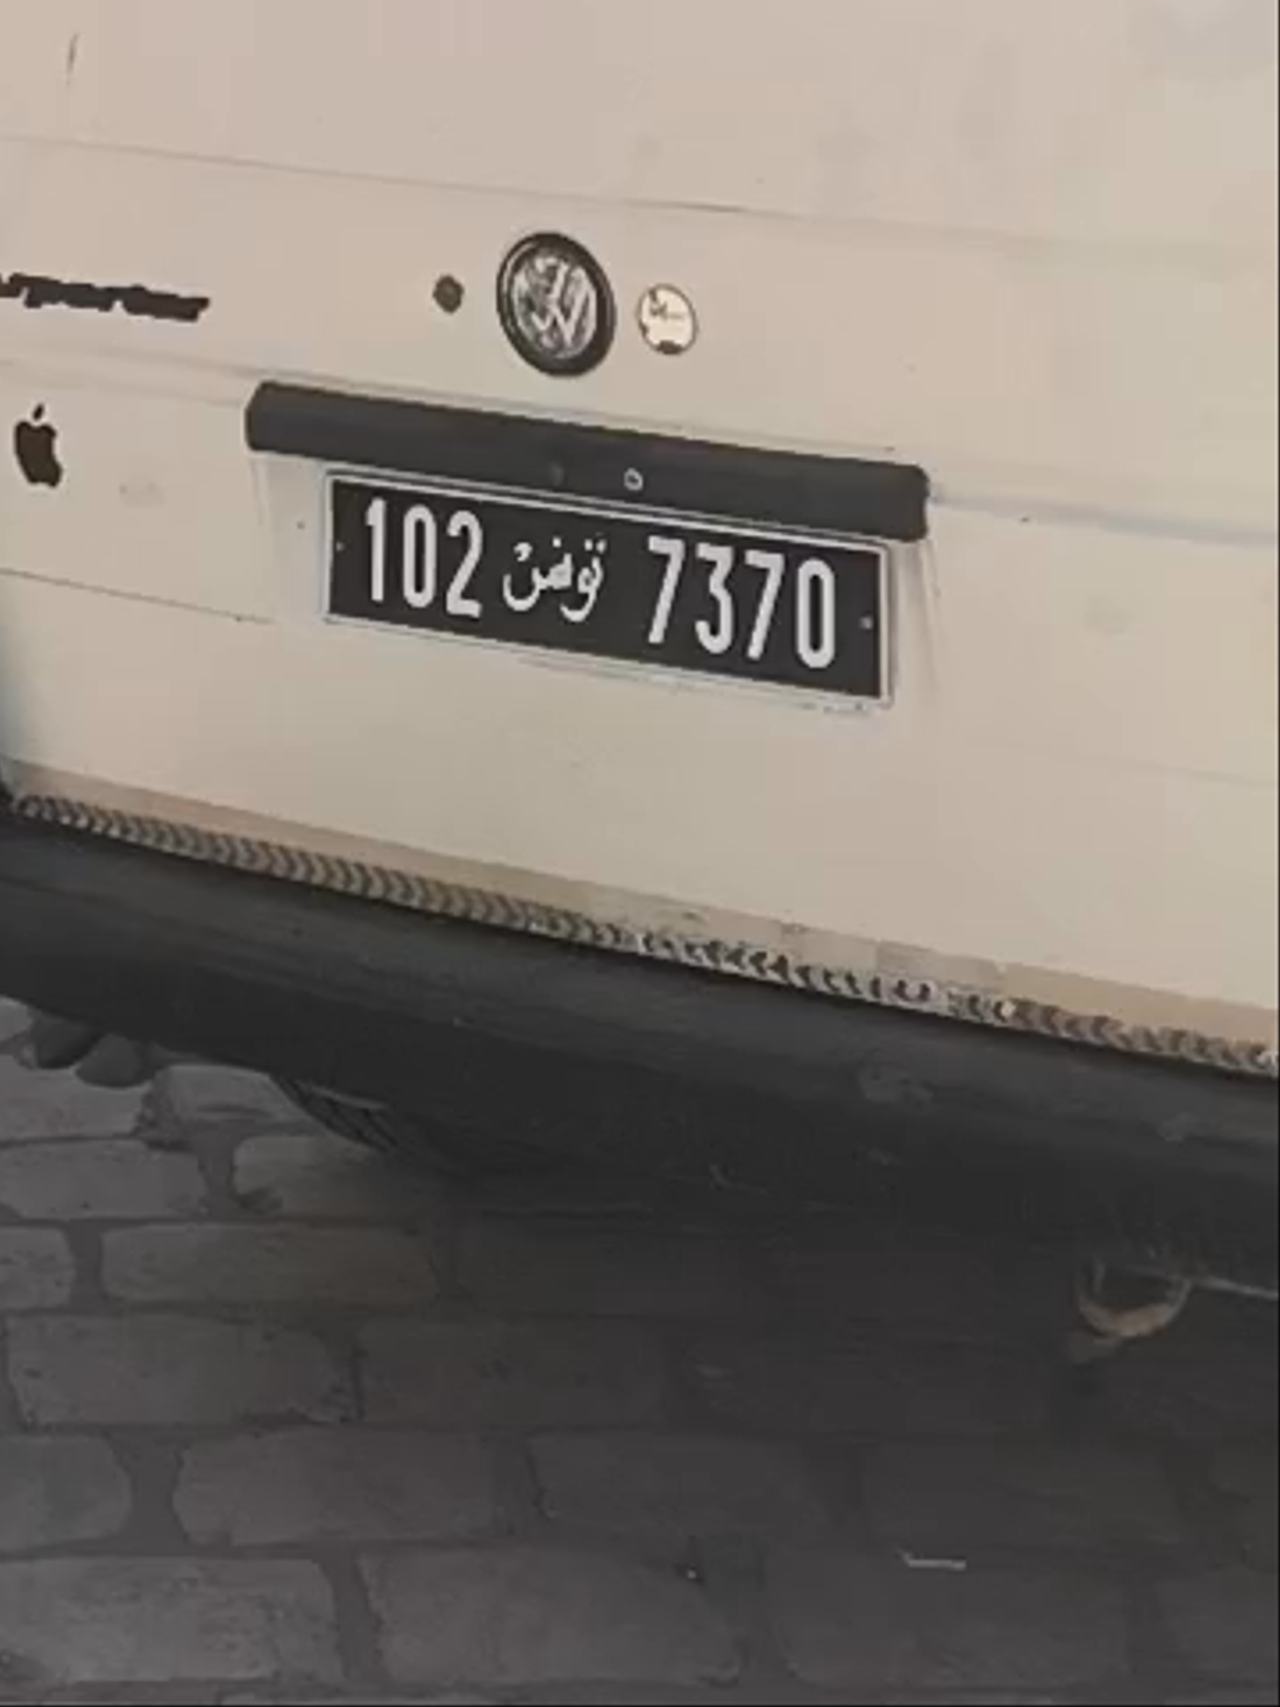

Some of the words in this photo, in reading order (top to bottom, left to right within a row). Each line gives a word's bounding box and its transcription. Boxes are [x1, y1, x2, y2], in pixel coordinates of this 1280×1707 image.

[365, 497, 484, 619] 102
[502, 535, 608, 623] تونس
[647, 534, 836, 669] 7370
